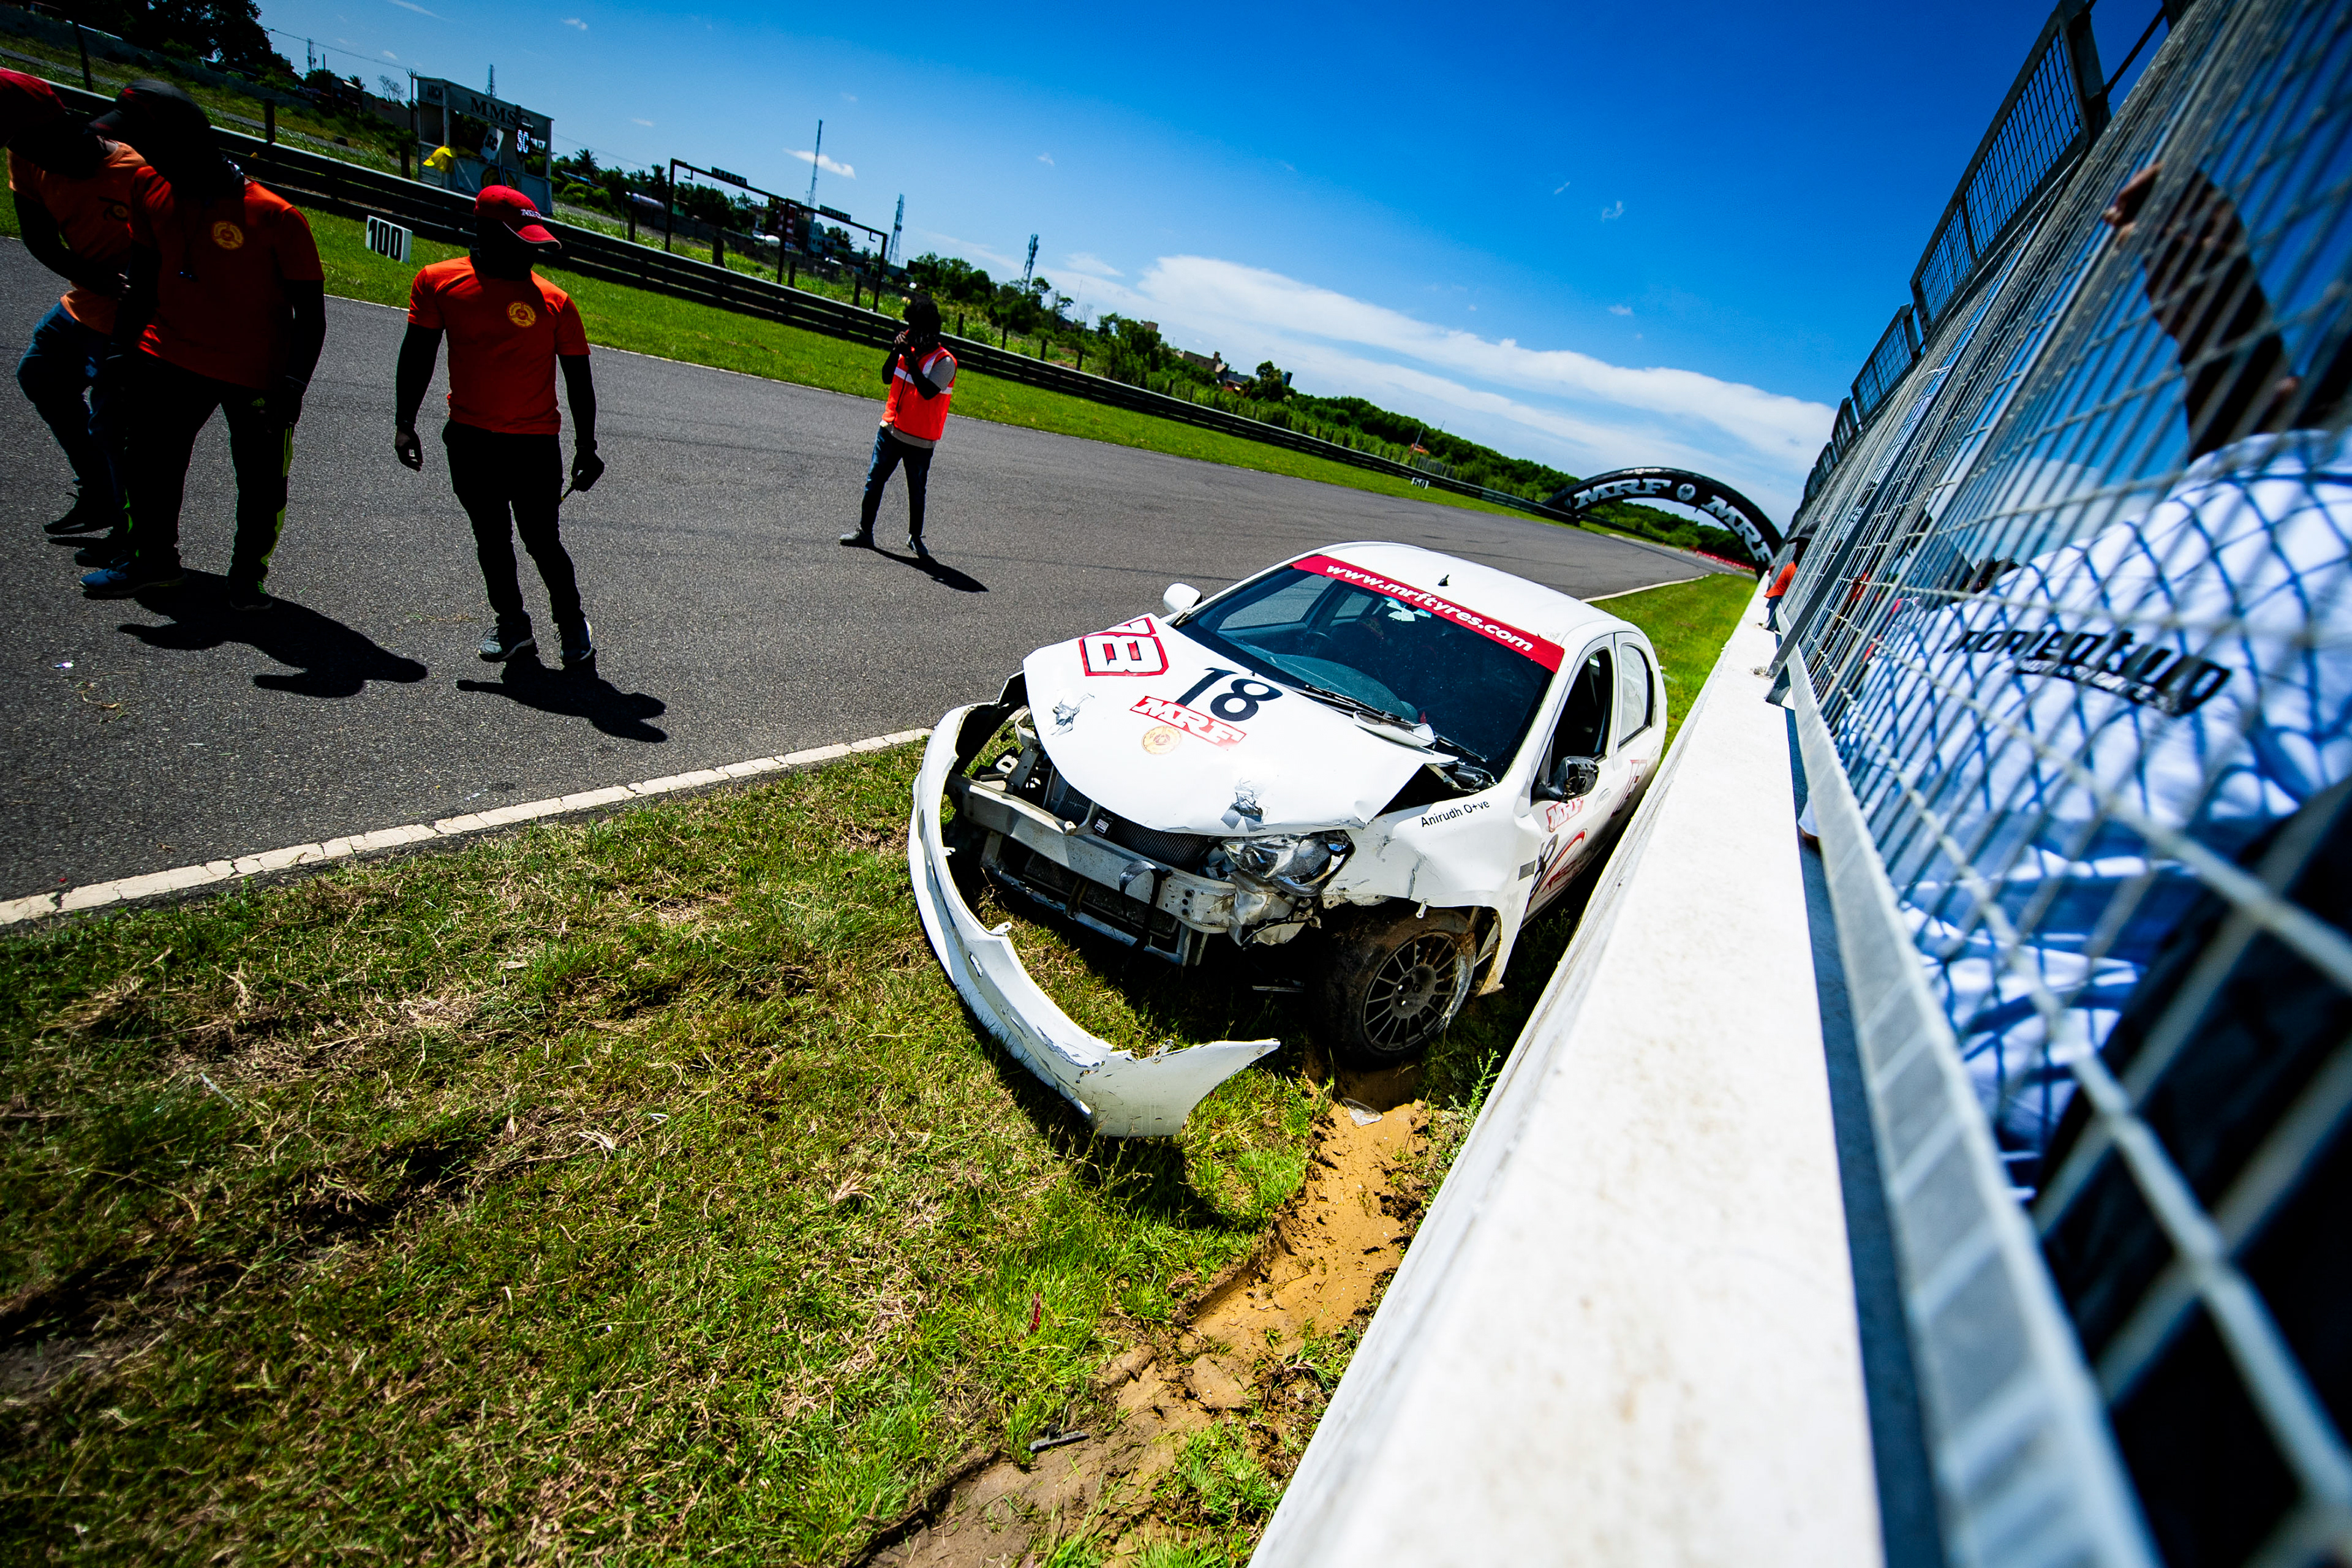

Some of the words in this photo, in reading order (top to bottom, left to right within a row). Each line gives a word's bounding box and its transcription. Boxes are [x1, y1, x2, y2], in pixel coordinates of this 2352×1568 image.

[484, 134, 499, 151] SC
[516, 129, 529, 154] SC
[368, 218, 403, 262] 100
[1574, 478, 1672, 510] MRF
[1700, 495, 1774, 566] MRF
[1326, 564, 1534, 652] www.mrftyres.com
[1174, 666, 1283, 722] 18
[1131, 696, 1246, 746] MRF
[1421, 807, 1463, 827] Anirudh
[1463, 801, 1490, 813] O+ve
